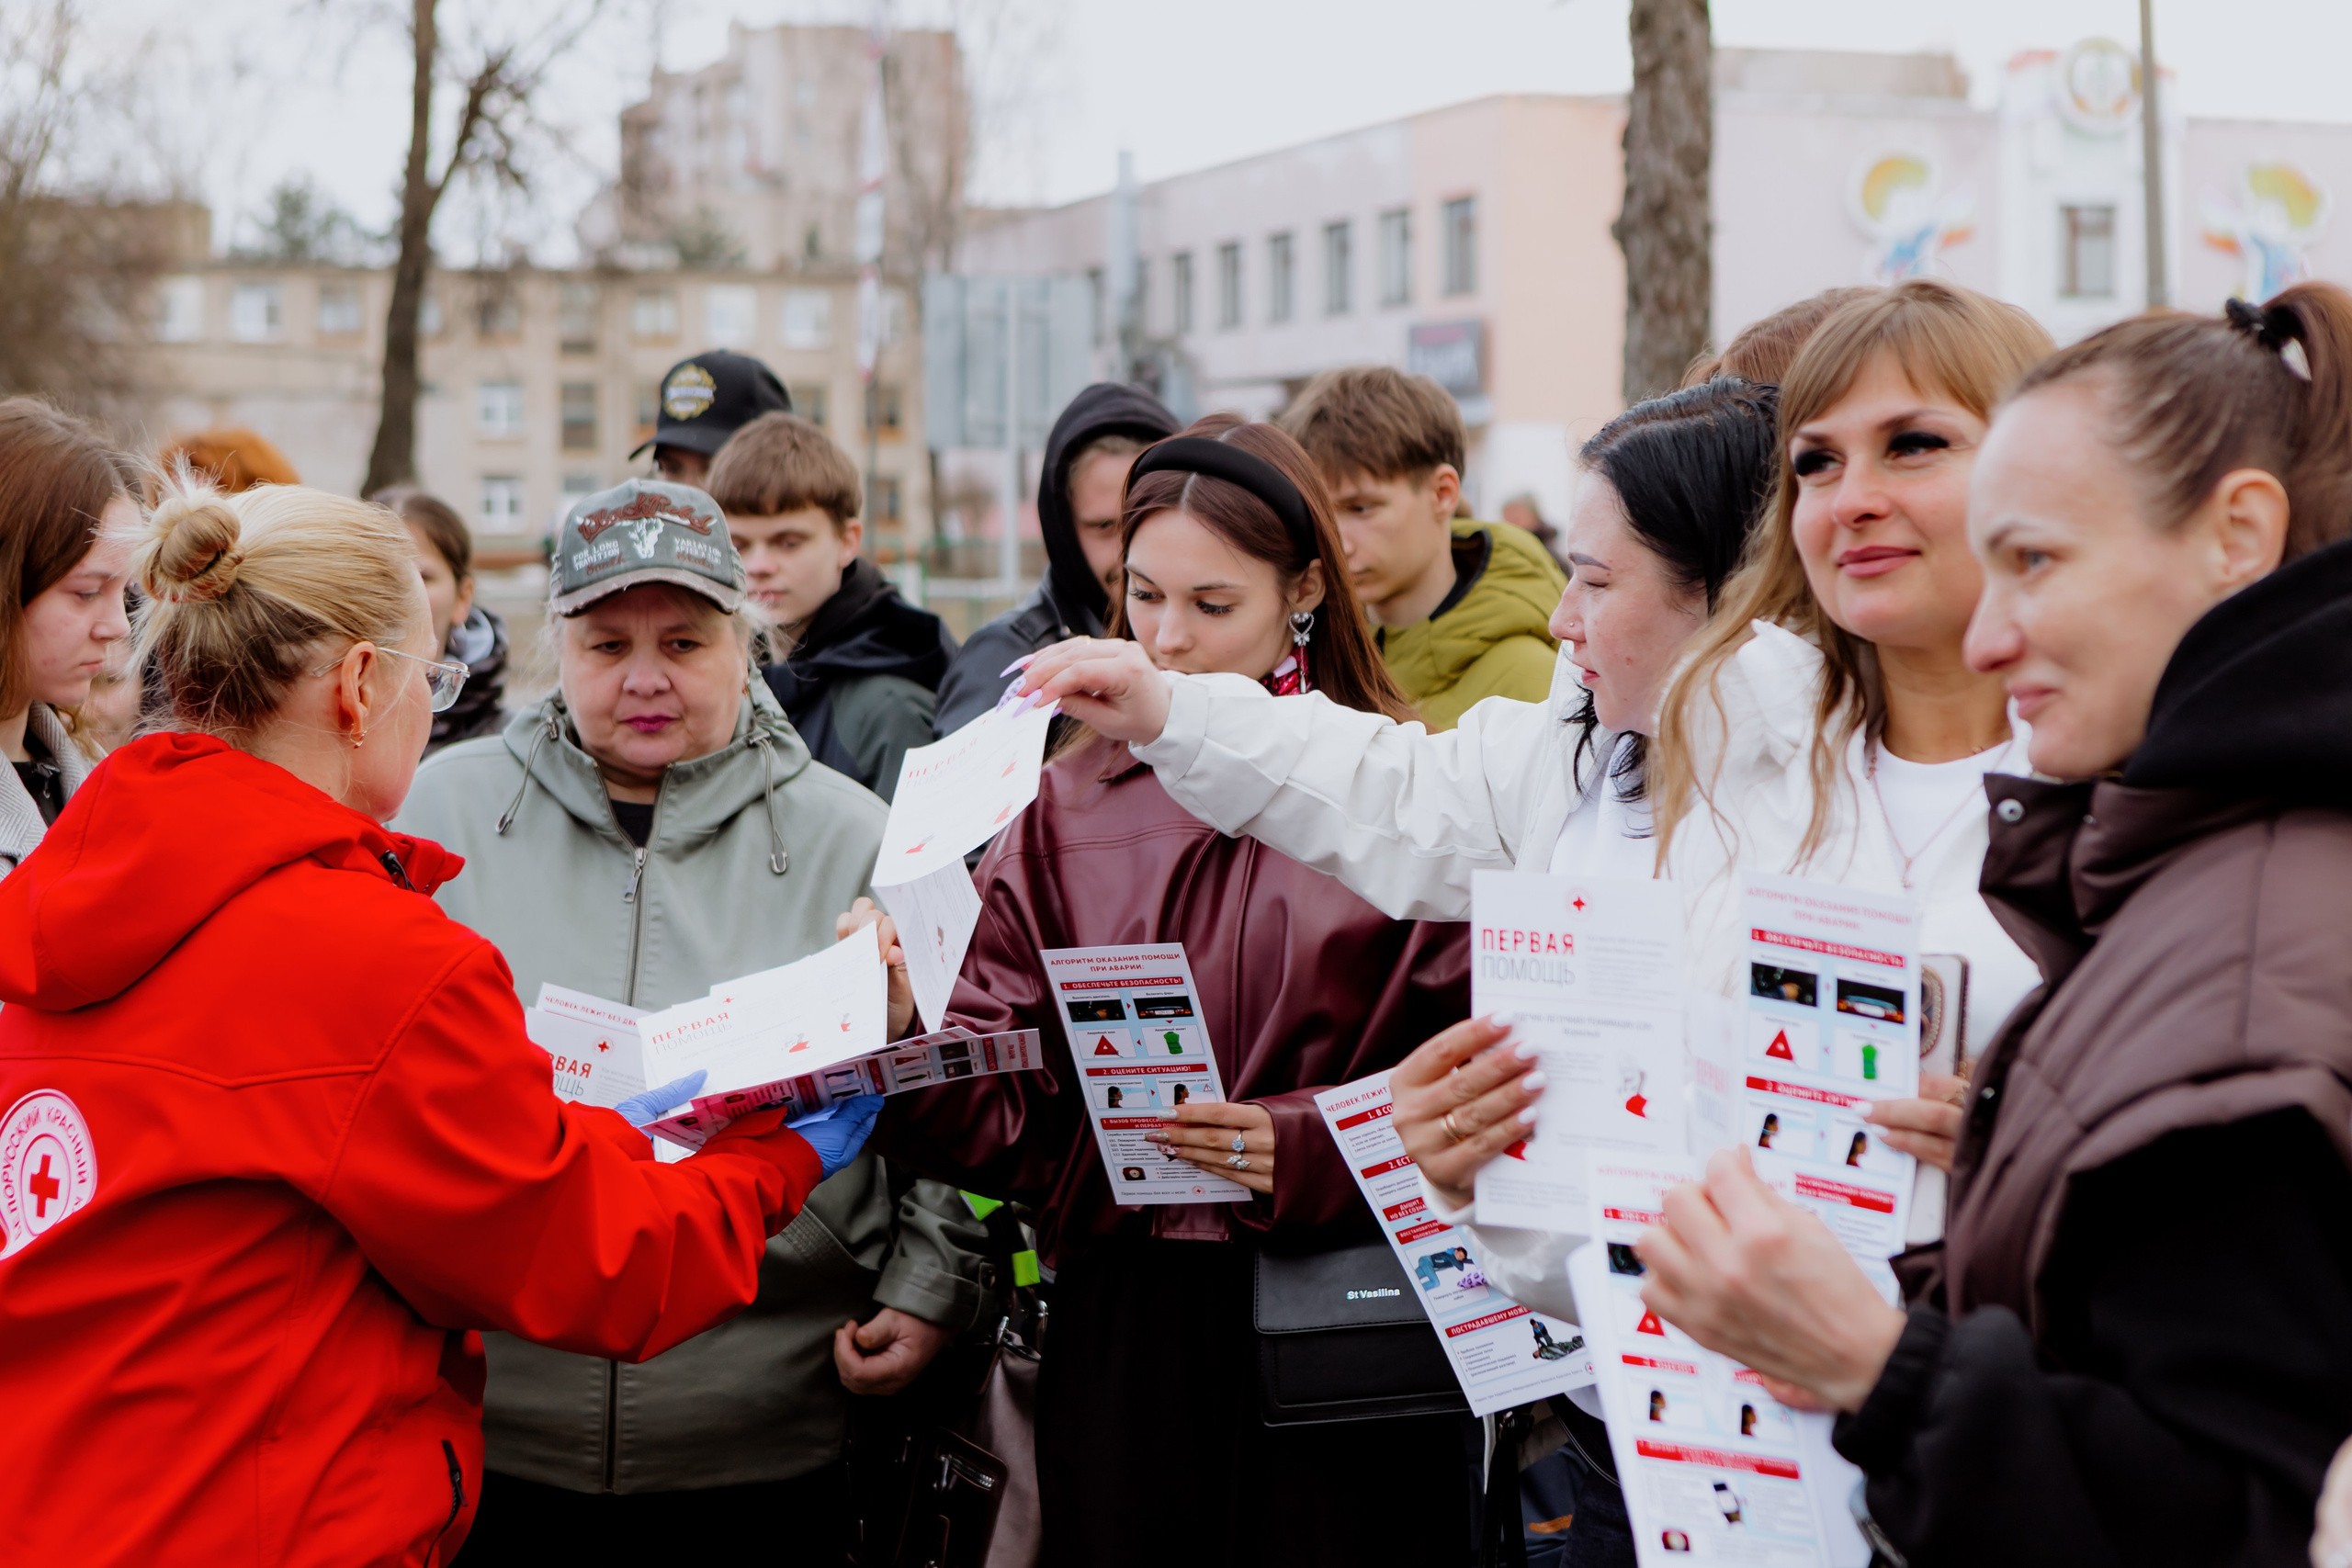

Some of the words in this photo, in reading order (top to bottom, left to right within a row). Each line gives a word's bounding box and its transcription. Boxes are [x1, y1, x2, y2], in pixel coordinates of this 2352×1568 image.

[572, 549, 589, 562] FOR
[593, 540, 618, 554] LONG
[674, 536, 721, 558] VARIATION
[573, 547, 619, 571] TRADITION
[1483, 929, 1575, 955] ПЕРВАЯ
[1050, 957, 1094, 965] АЛГОРИТМ
[1095, 954, 1140, 964] ОКАЗАНИЯ
[1141, 953, 1181, 962] ПОМОЩИ
[1109, 964, 1145, 972] АВАРИИ:
[1481, 955, 1576, 987] ПОМОЩЬ
[1072, 980, 1118, 989] ОБЕСПЕЧЬТЕ
[1120, 977, 1182, 987] БЕЗОПАСНОСТЬ!
[545, 996, 578, 1010] ЧЕЛОВЕК
[581, 1006, 606, 1018] ЛЕЖИТ
[607, 1014, 621, 1022] БЕЗ
[652, 1012, 729, 1044] ПЕРВАЯ
[655, 1023, 732, 1055] ПОМОЩЬ
[1147, 1066, 1191, 1074] СИТУАЦИЮ!
[1326, 1096, 1360, 1112] ЧЕЛОВЕК
[1361, 1087, 1388, 1101] ЛЕЖИТ
[1368, 1111, 1376, 1120] 1.
[1376, 1108, 1383, 1116] В
[47, 1105, 90, 1185] КРАСНЫЙ
[1388, 1161, 1397, 1169] 2.
[1390, 1212, 1398, 1220] НО
[1398, 1209, 1409, 1217] БЕЗ
[1408, 1204, 1426, 1214] СОЗНА
[1413, 1227, 1440, 1239] ПОЛОЖЕНИЕ
[1346, 1290, 1359, 1300] St
[1359, 1288, 1400, 1299] Vasilina
[1451, 1313, 1508, 1335] ПОСТРАДАВШЕМУ
